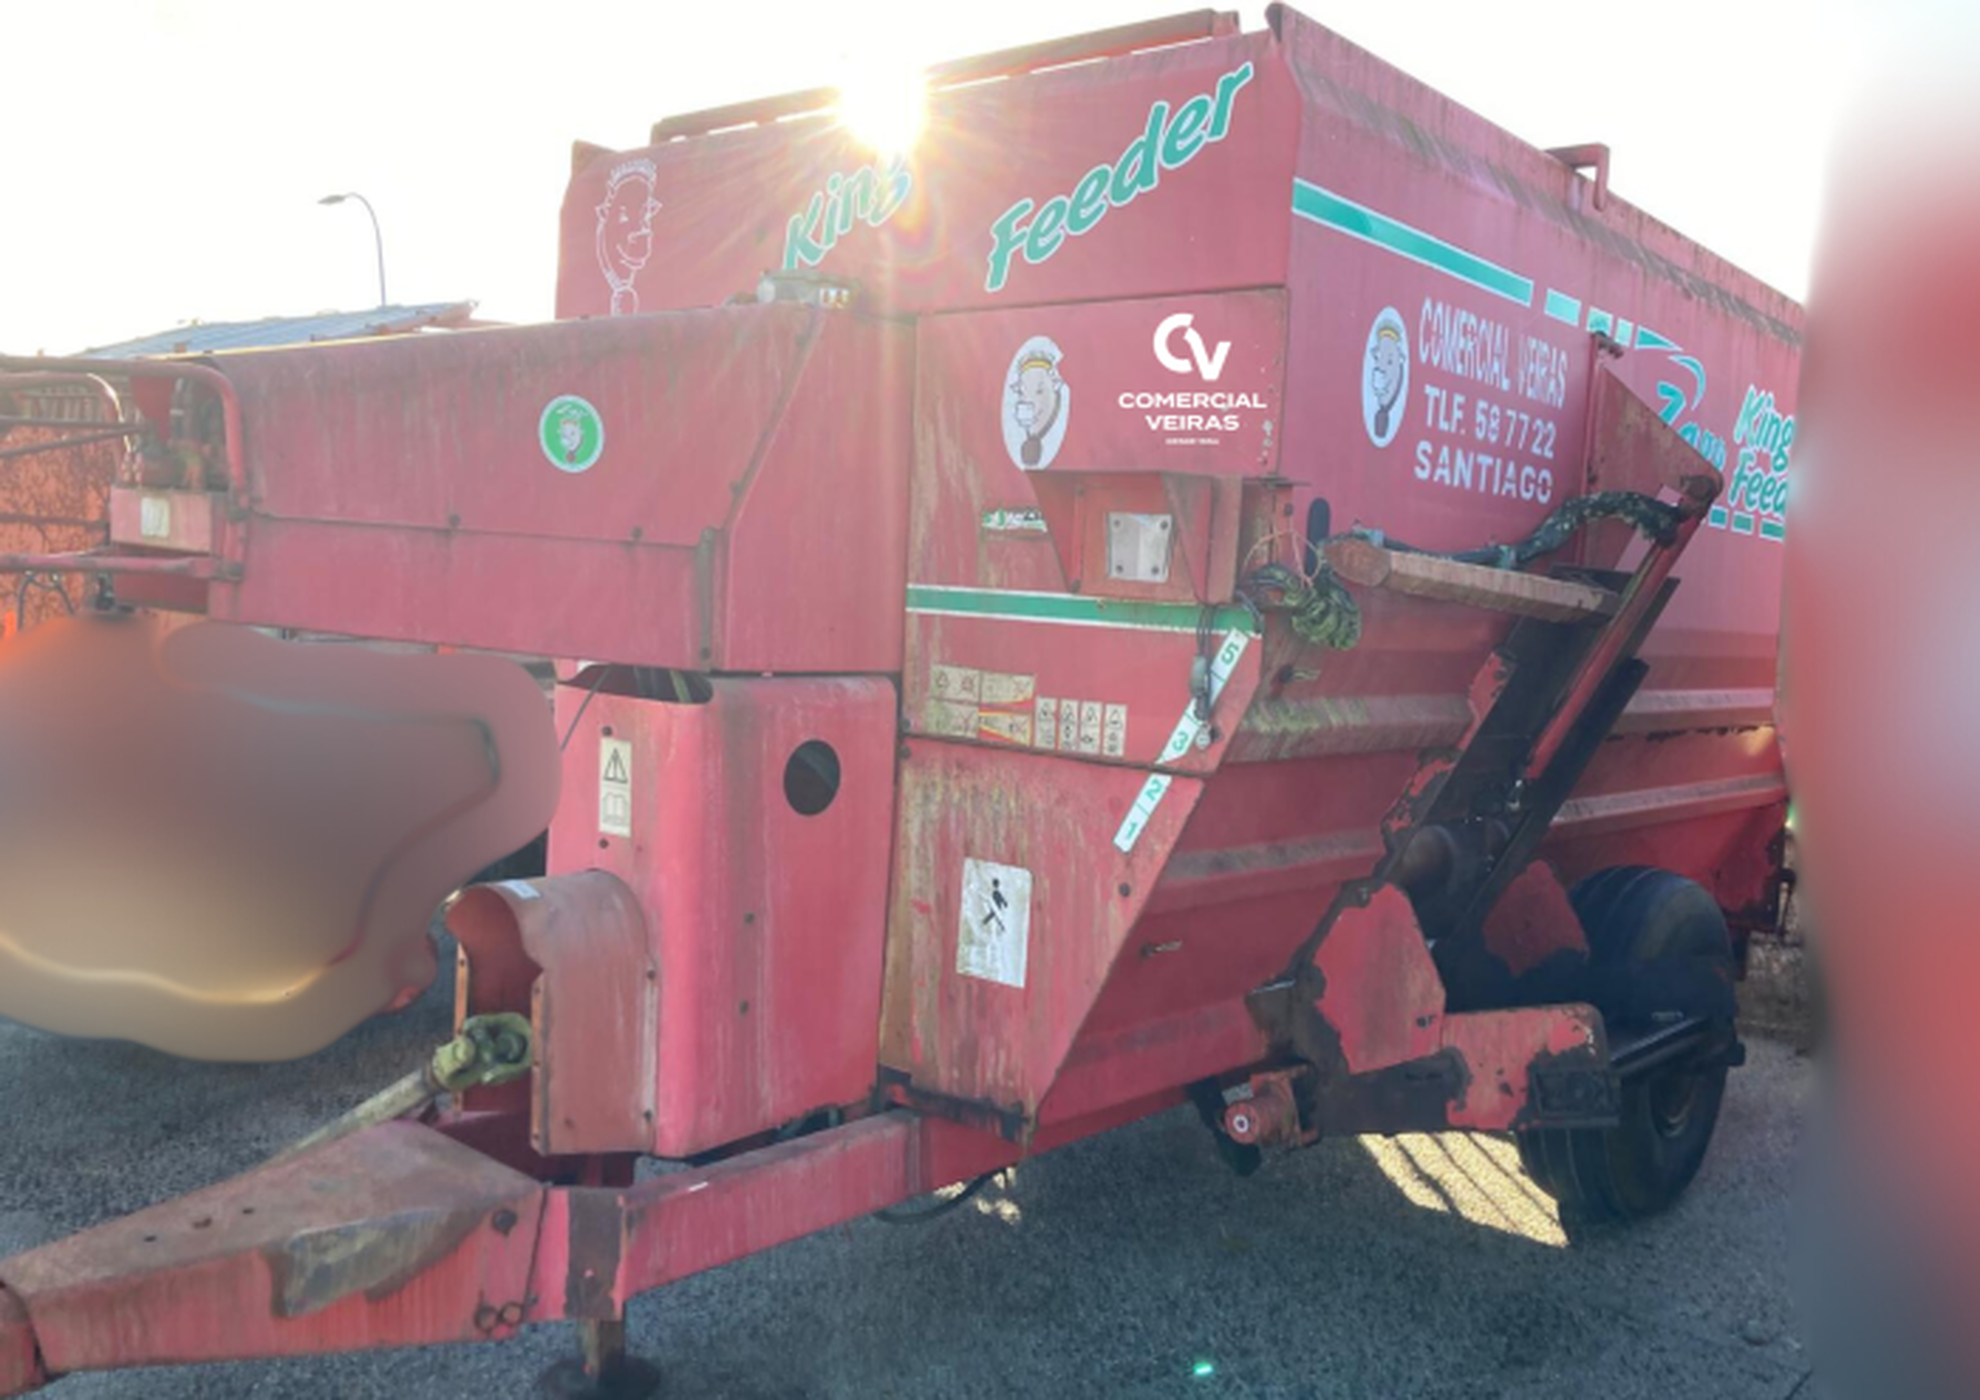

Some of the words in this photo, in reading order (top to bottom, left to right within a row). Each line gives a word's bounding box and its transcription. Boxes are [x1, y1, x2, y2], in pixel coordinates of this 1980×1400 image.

[985, 61, 1254, 295] Feeder
[1419, 297, 1510, 391] COMERCIAL
[1517, 333, 1567, 410] VEIRAS
[1424, 384, 1467, 435] TLF.
[1733, 384, 1795, 474] King
[1414, 439, 1553, 505] SANTIAGO
[1220, 642, 1240, 665] 5
[1172, 731, 1189, 752] 3
[1146, 778, 1163, 801] 2
